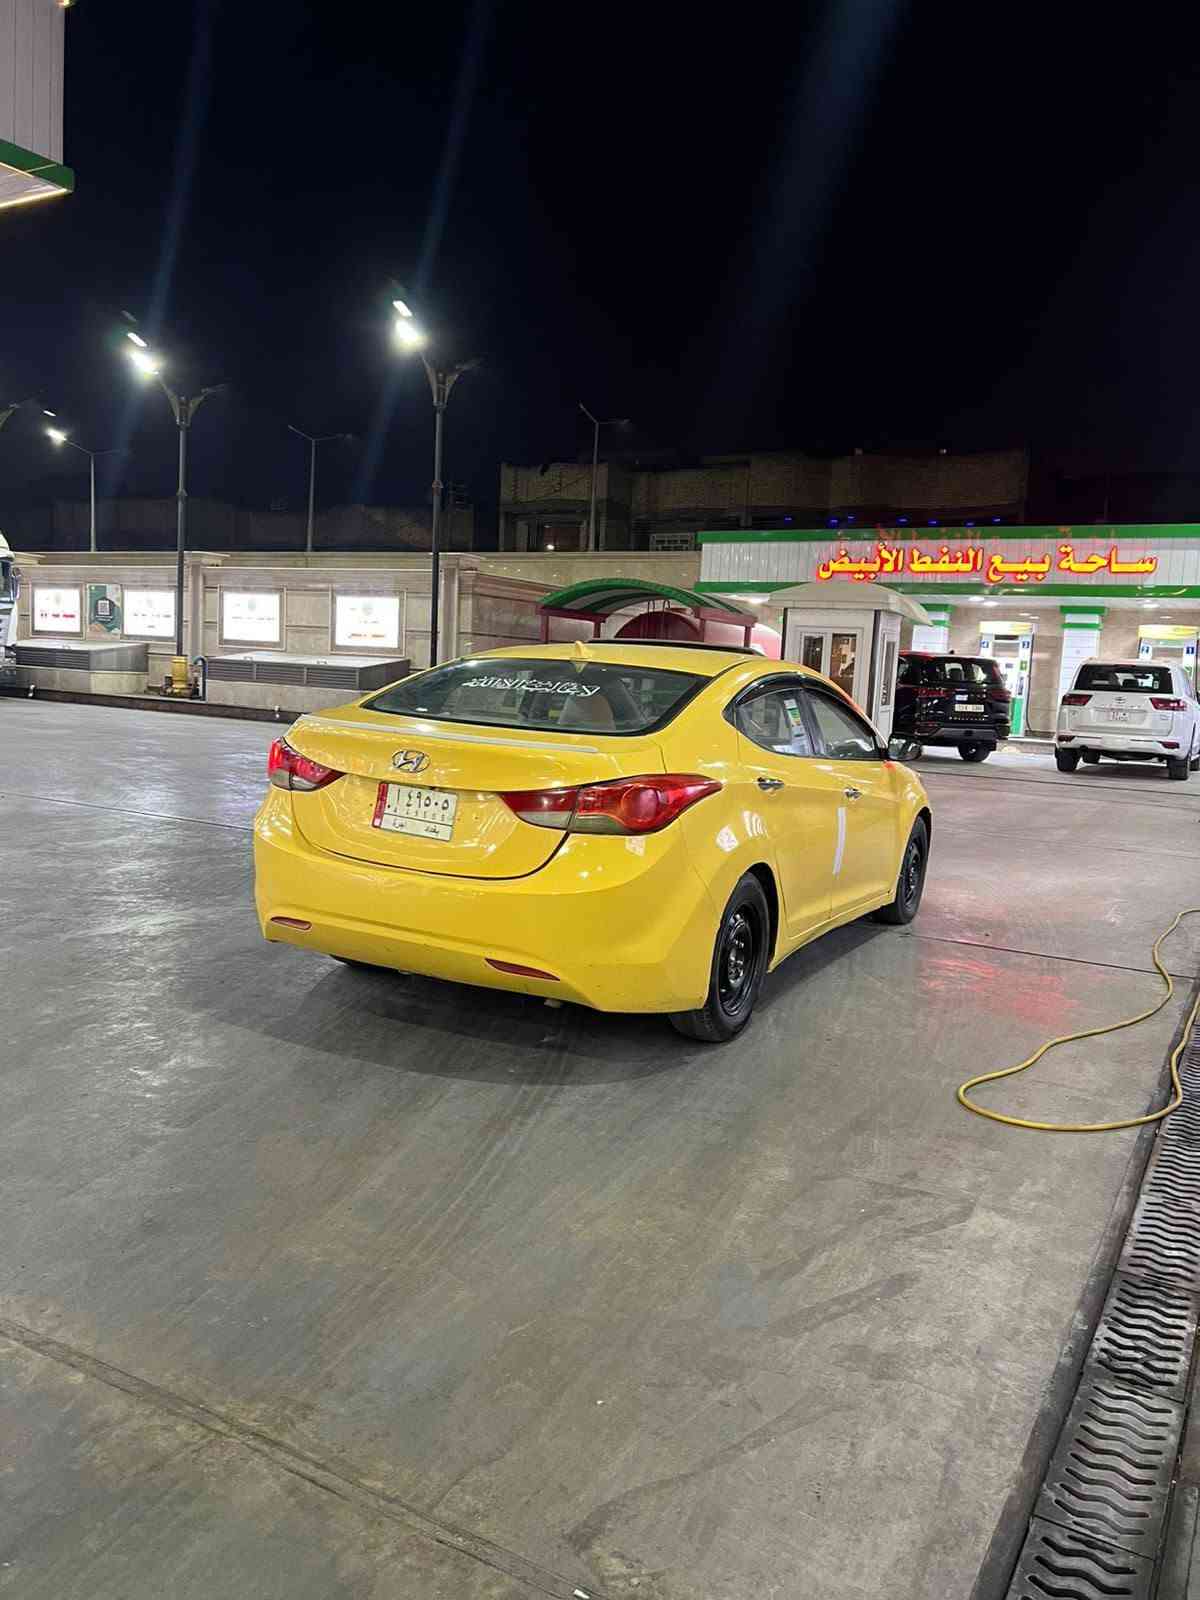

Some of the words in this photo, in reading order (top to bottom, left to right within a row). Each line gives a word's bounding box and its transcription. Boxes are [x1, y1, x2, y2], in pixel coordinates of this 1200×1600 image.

[816, 540, 904, 581] الأبيض
[908, 545, 984, 573] النفط
[986, 553, 1052, 582] بيع
[1056, 544, 1158, 574] ساحة
